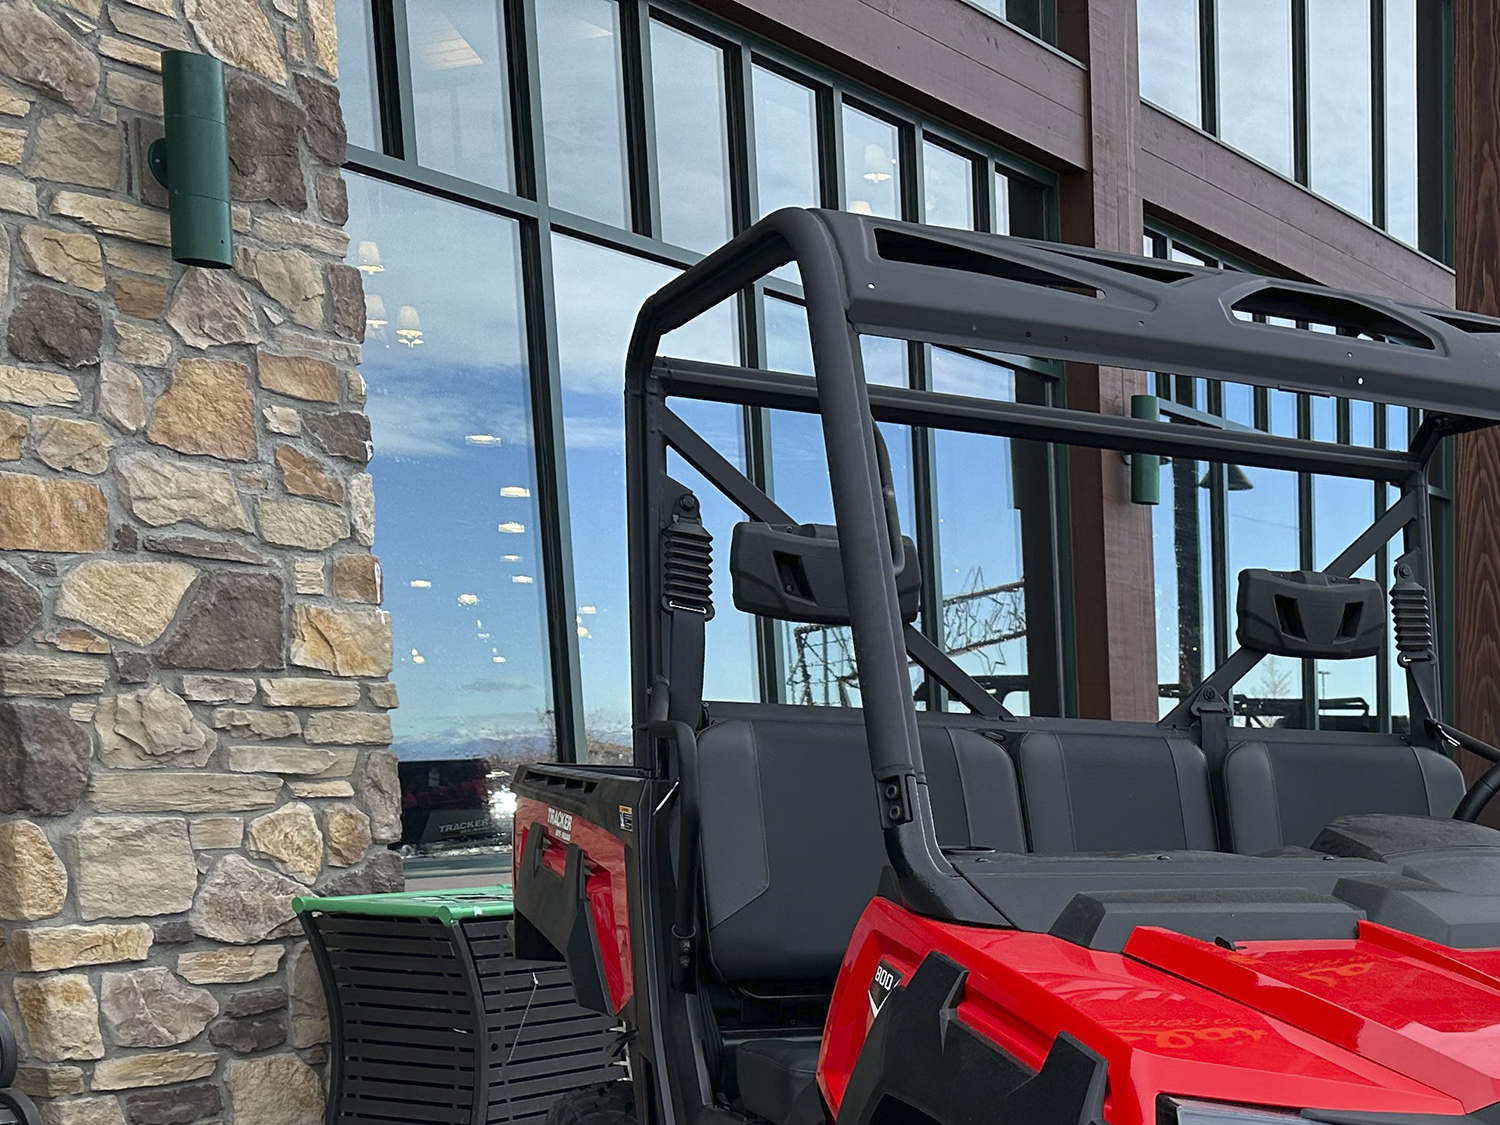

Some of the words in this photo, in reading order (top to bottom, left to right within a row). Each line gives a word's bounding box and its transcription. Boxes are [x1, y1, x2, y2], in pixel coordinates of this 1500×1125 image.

[439, 818, 489, 833] TRACKER
[547, 807, 573, 832] TRACKER
[874, 965, 894, 991] 800
